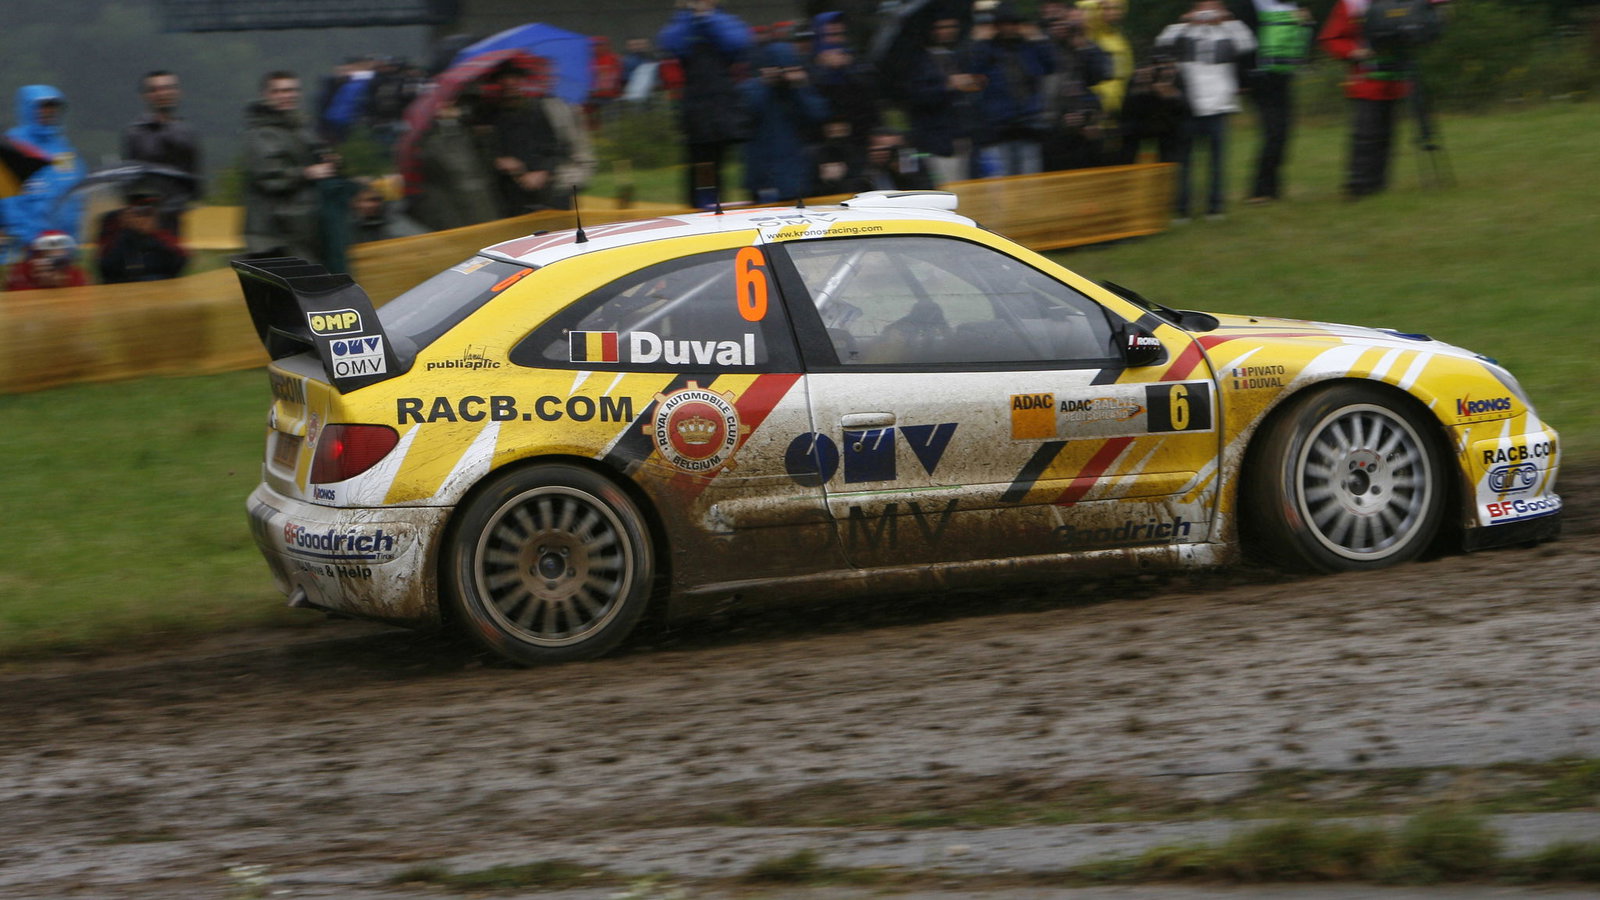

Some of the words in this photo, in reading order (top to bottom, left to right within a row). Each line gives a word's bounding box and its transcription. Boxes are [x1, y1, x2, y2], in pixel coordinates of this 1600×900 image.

[766, 224, 883, 239] www.kronosracing.com
[735, 246, 768, 322] 6
[311, 312, 357, 331] OMP
[630, 331, 755, 367] Duval
[336, 358, 381, 376] OMV
[1248, 365, 1285, 376] PIVATO
[1249, 377, 1285, 389] DUVAL
[396, 395, 633, 425] RACB.COM
[1013, 394, 1053, 410] ADAC
[1060, 400, 1092, 412] ADAC
[1169, 384, 1190, 431] 6
[1456, 394, 1511, 416] KRONOS
[656, 412, 669, 447] ROYAL
[665, 392, 731, 416] AUTOMOBILE
[726, 415, 738, 446] CLUB
[672, 455, 721, 471] BELGIUM
[284, 522, 393, 552] BFGoodrich
[326, 564, 335, 578] &
[337, 565, 372, 581] Help
